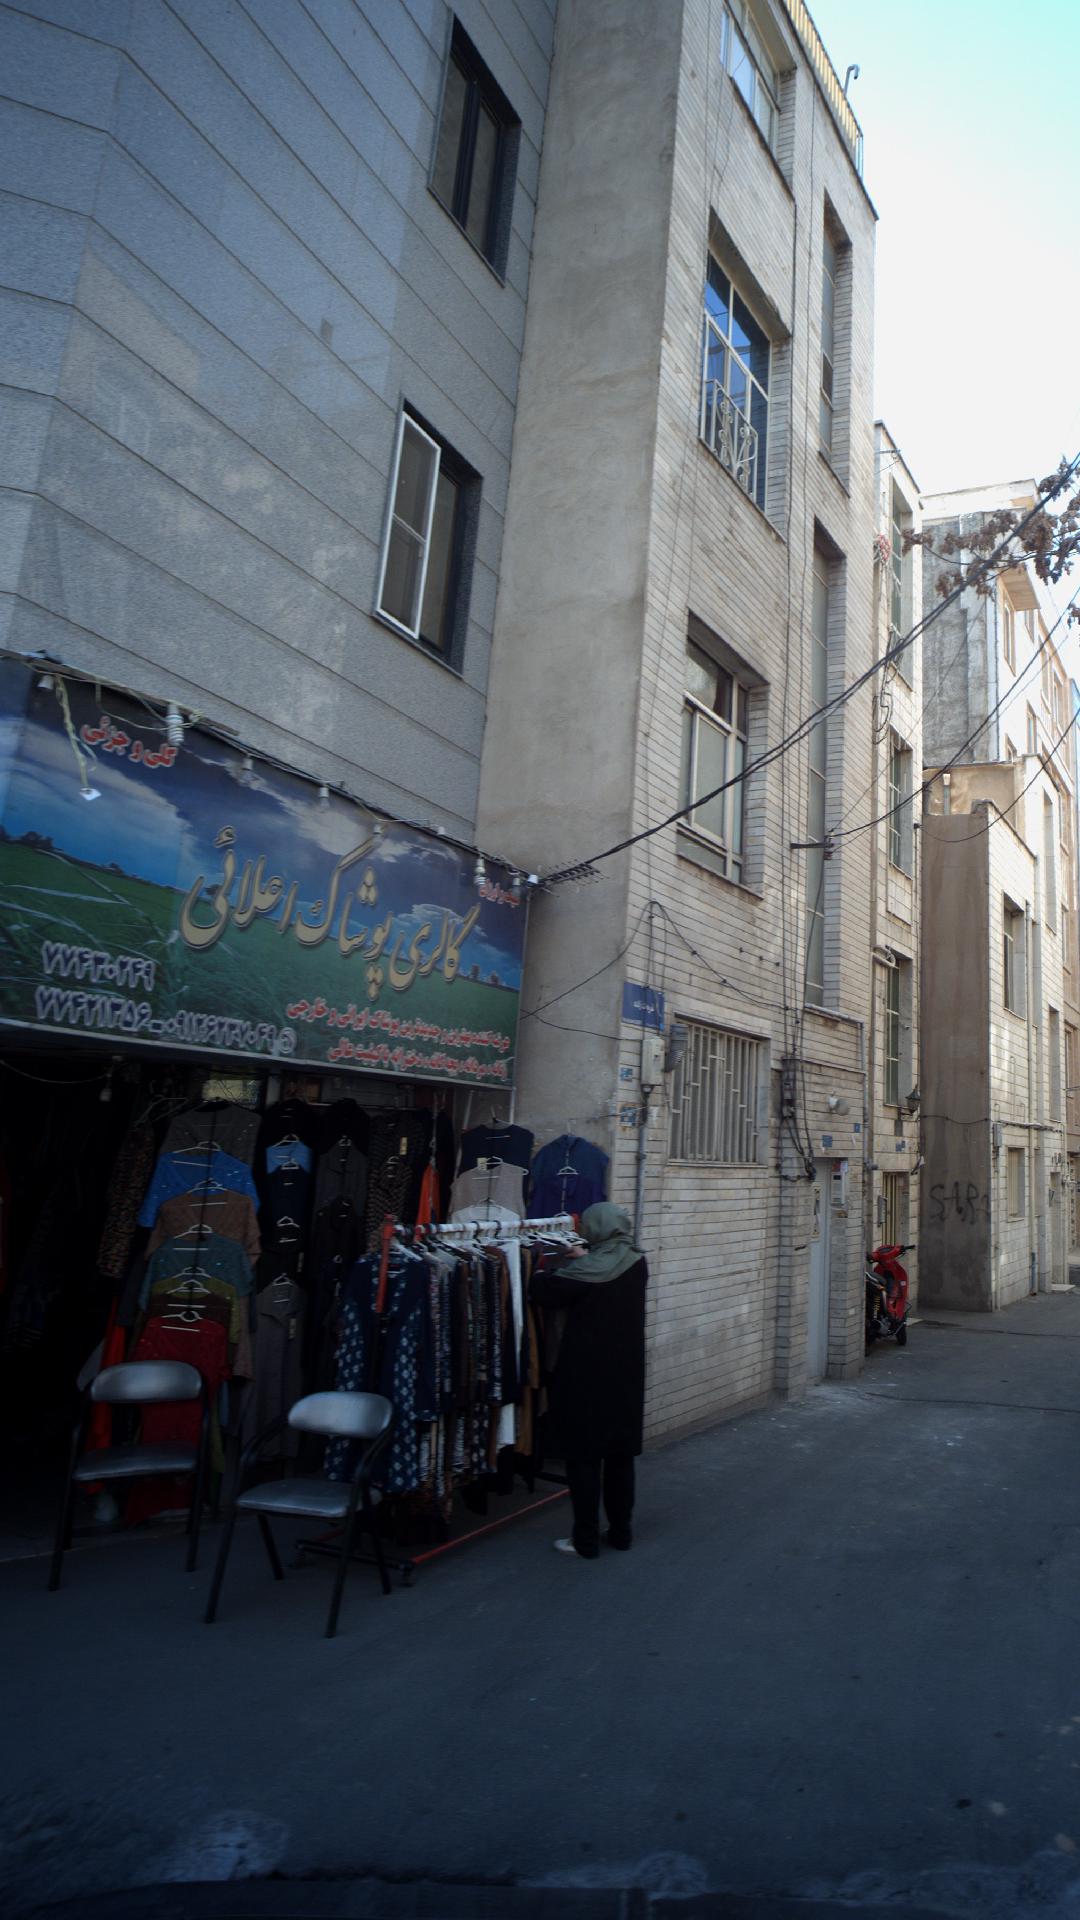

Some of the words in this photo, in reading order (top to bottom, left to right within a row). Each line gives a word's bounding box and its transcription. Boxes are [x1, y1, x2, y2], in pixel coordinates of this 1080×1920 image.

[80, 715, 131, 756] جزئی
[128, 740, 144, 763] و
[143, 742, 178, 769] کلی
[294, 822, 395, 1003] پوشاک
[287, 997, 326, 1020] خارجی
[328, 1008, 337, 1026] و
